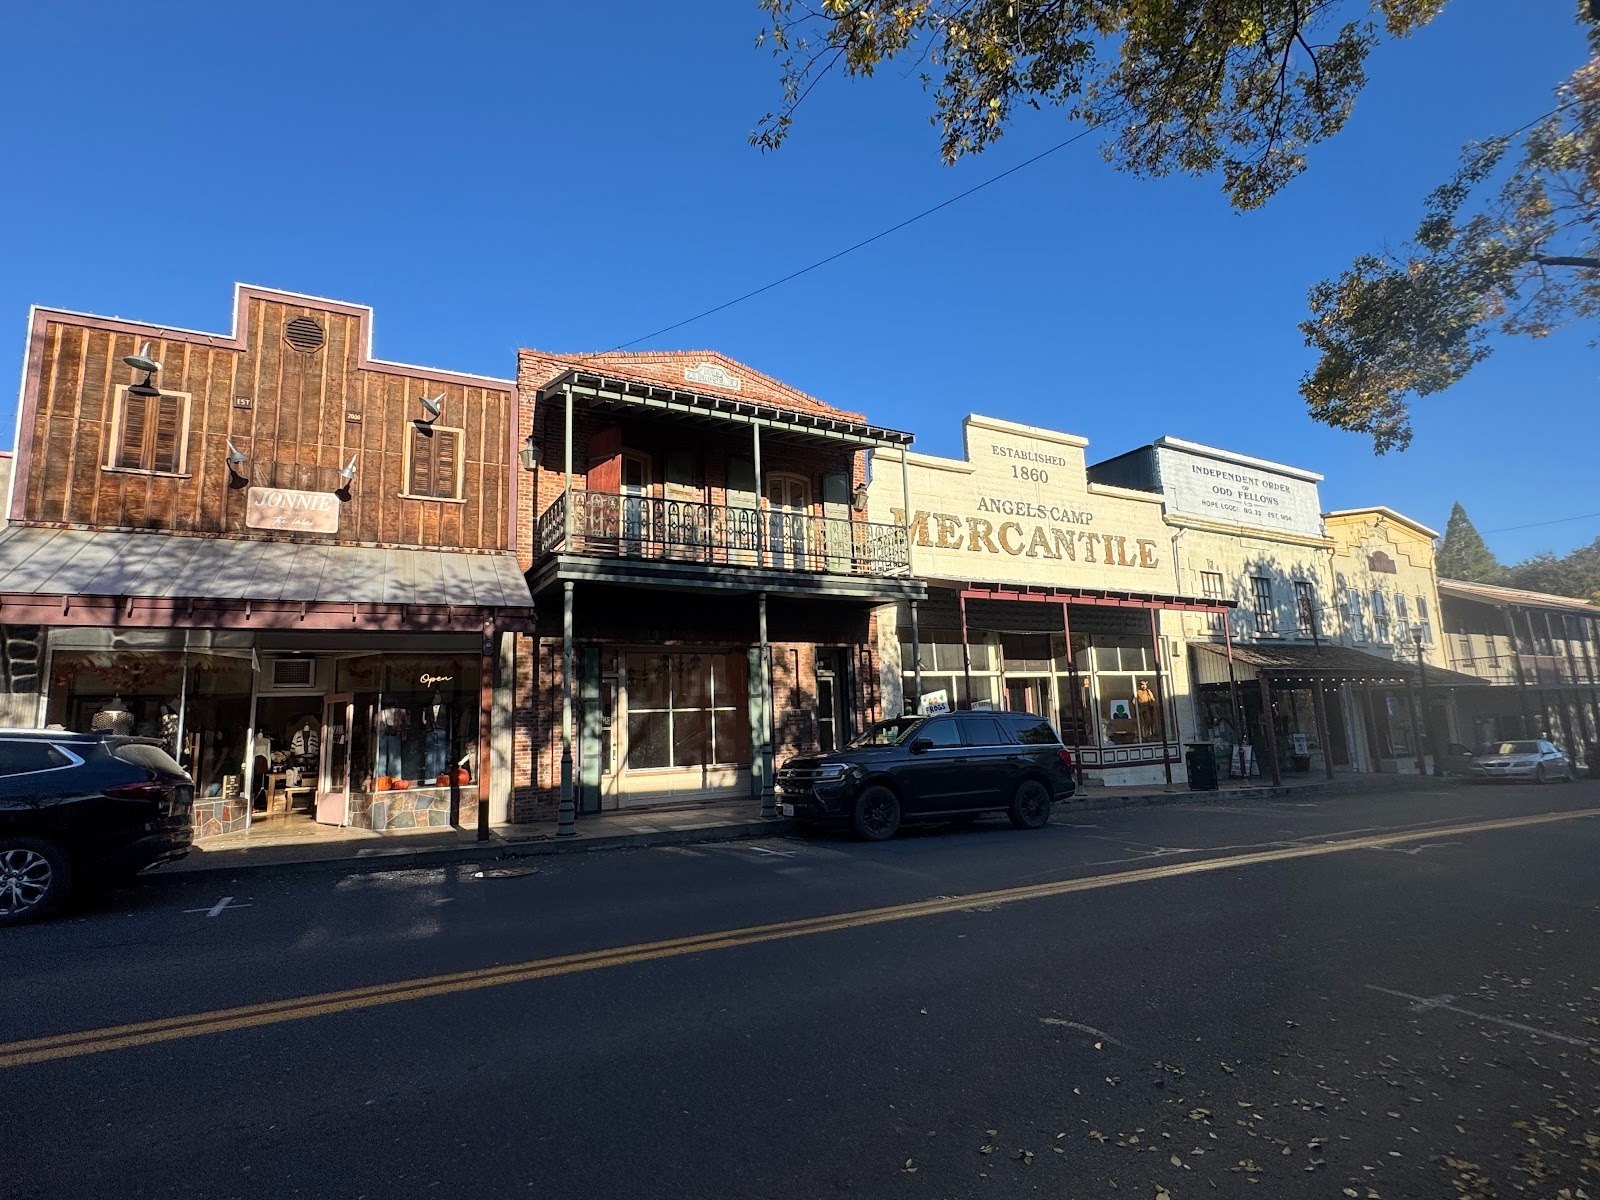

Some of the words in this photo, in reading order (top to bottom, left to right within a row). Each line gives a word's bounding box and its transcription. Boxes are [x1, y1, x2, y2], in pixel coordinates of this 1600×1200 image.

[236, 398, 251, 406] EST
[991, 444, 1066, 467] ESTABLISHED
[1011, 464, 1049, 484] 1860
[1192, 464, 1259, 487] INDEPENDENT
[1261, 479, 1291, 493] ORDER
[254, 490, 334, 512] JONNIE
[1201, 499, 1219, 509] HOPE
[1212, 485, 1233, 497] ODD
[1237, 490, 1279, 506] FELLOWS
[977, 496, 1047, 520] ANGELS
[1049, 506, 1093, 526] CAMP
[889, 507, 1160, 569] MERCANTILE
[420, 673, 453, 688] Open
[925, 703, 946, 714] FROGS
[928, 697, 938, 705] GO
